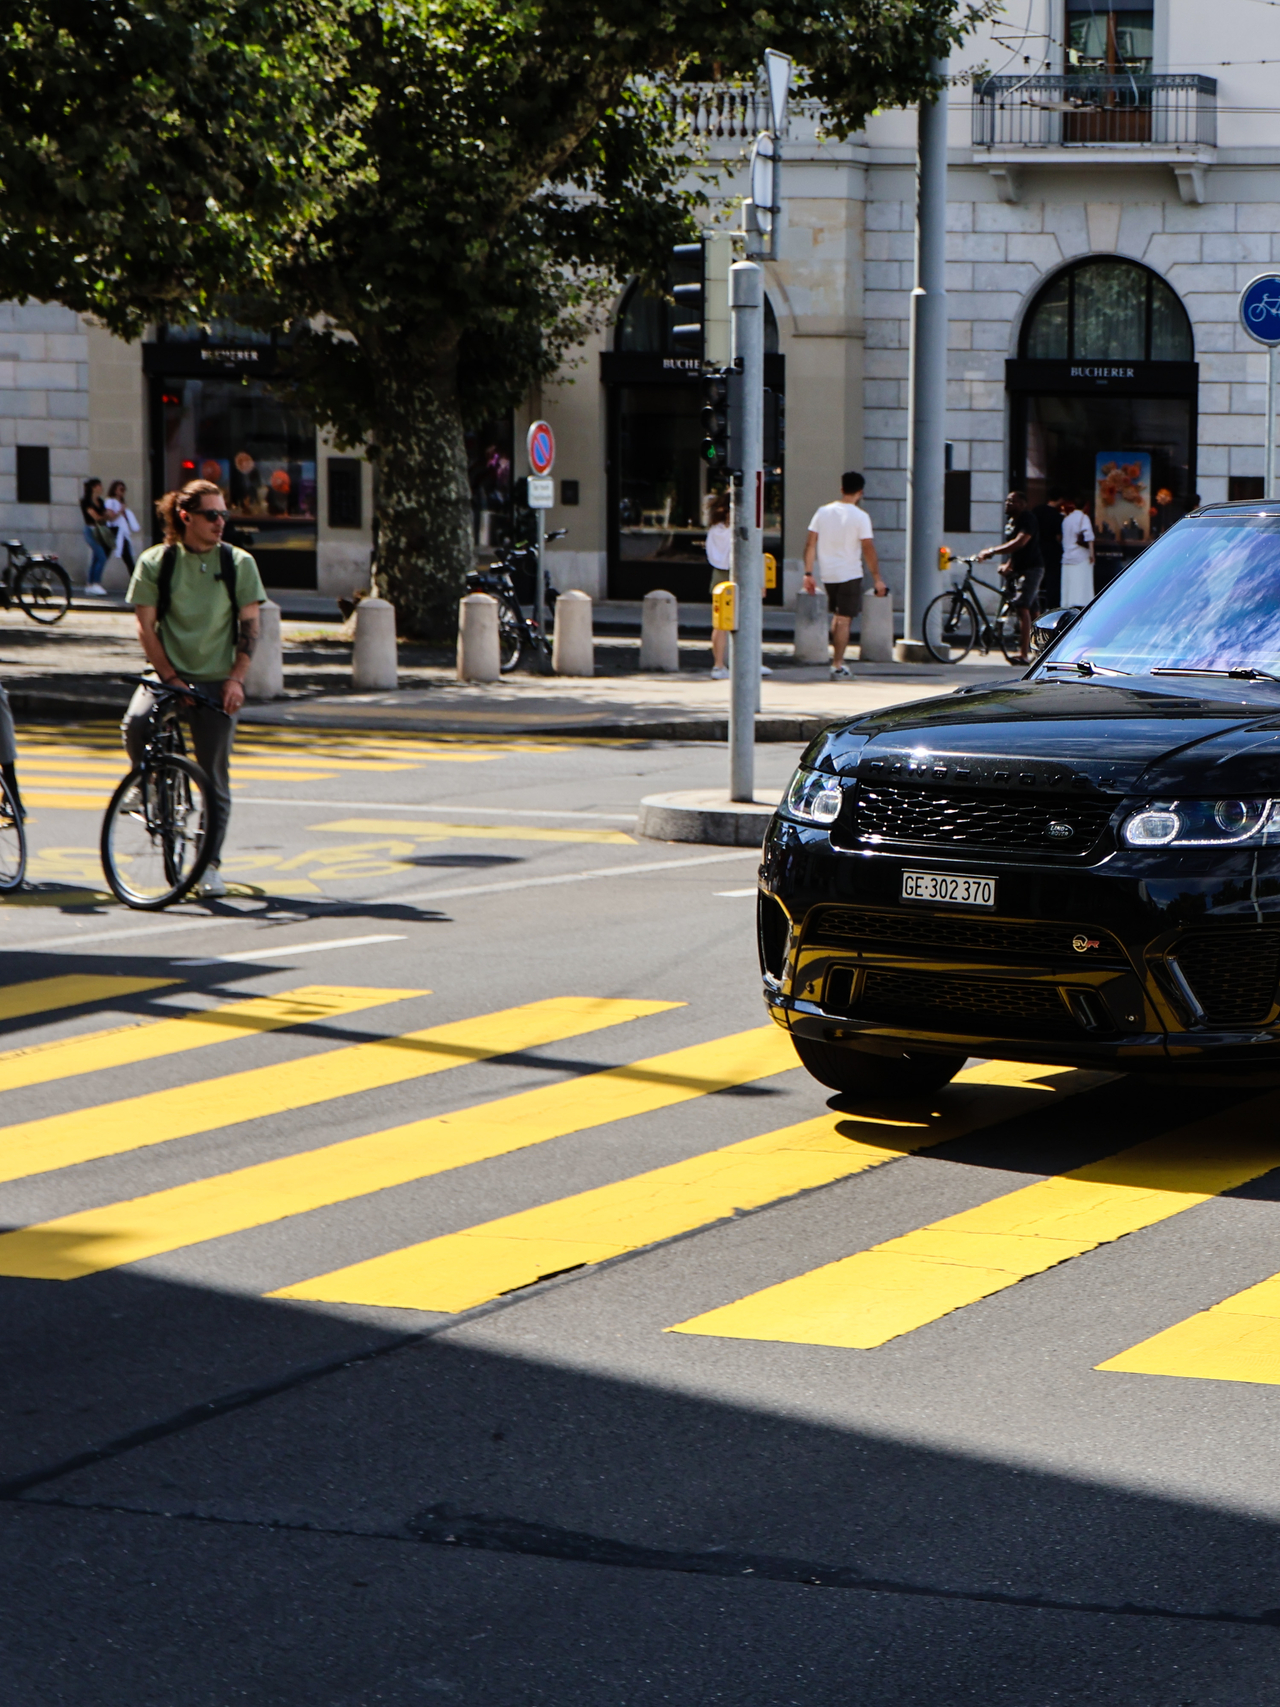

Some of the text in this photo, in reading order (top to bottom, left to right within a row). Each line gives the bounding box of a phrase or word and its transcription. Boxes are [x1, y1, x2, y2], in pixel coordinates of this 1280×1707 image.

[663, 358, 701, 370] BUCHE
[1070, 366, 1135, 378] BUCHERER
[870, 761, 1116, 788] RANGE ROVER
[1073, 938, 1099, 950] SVR
